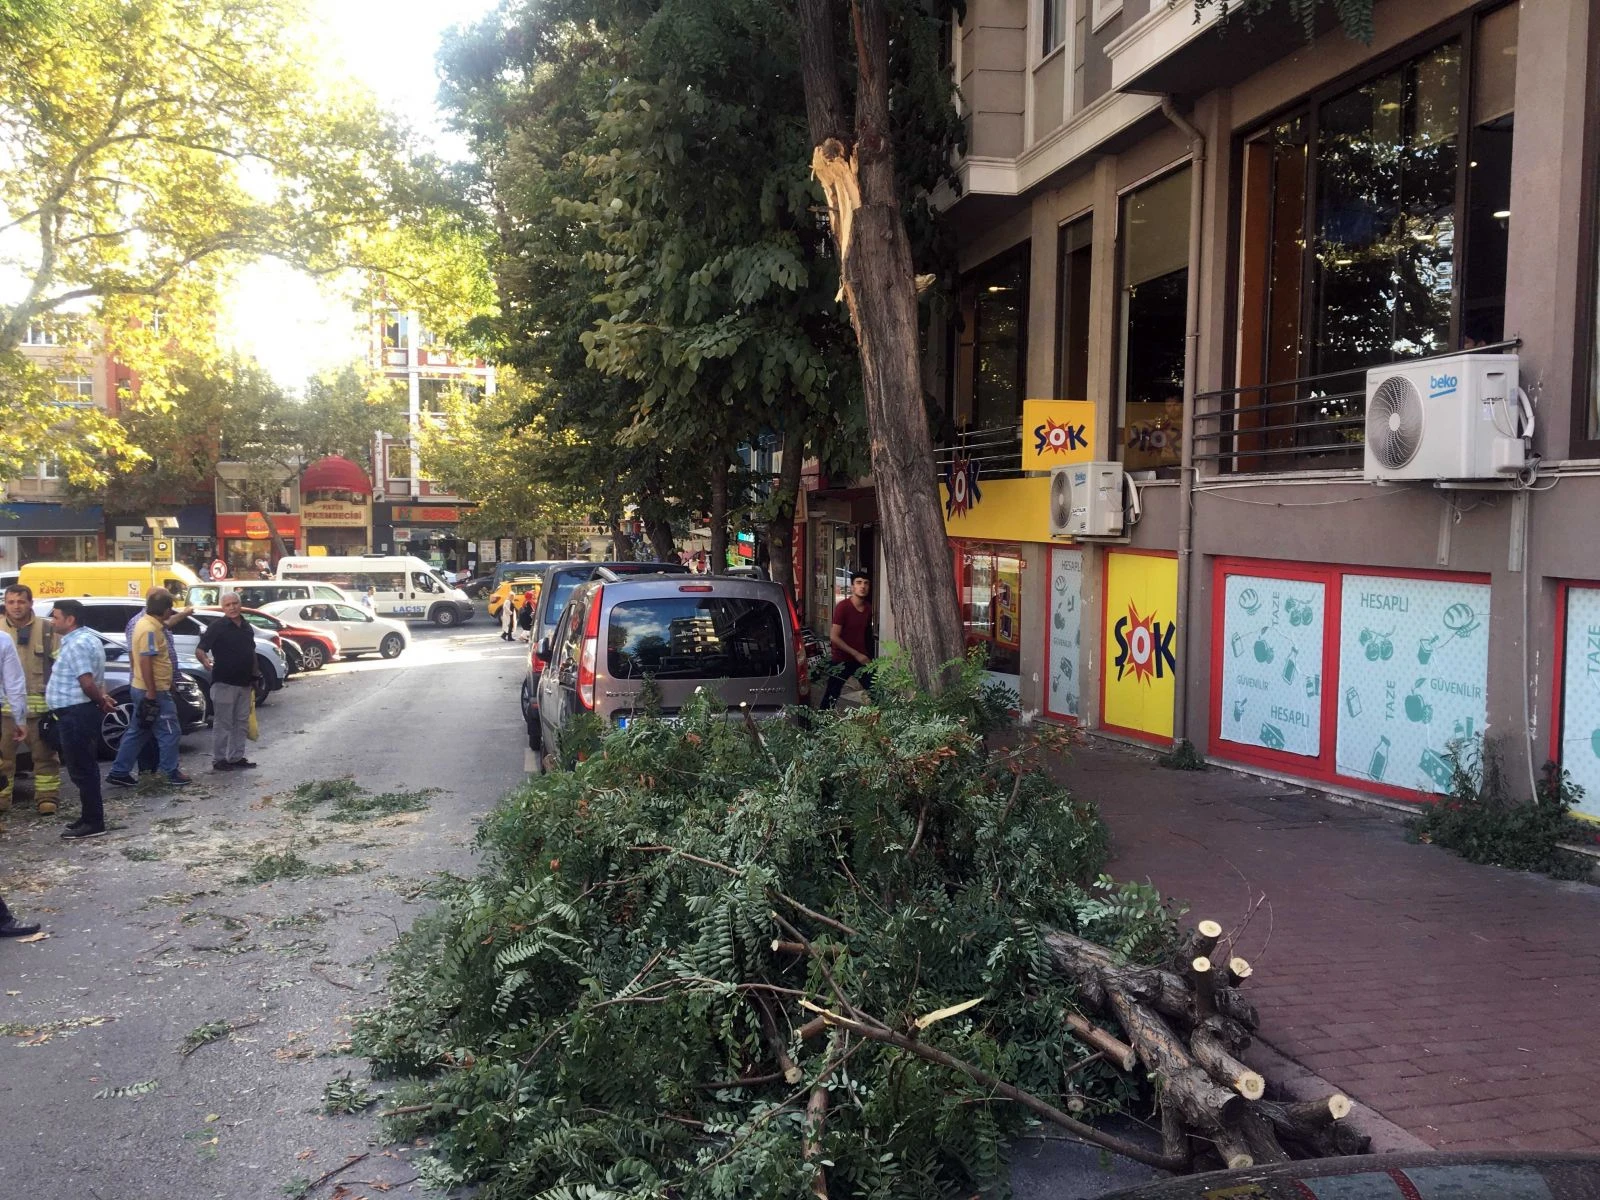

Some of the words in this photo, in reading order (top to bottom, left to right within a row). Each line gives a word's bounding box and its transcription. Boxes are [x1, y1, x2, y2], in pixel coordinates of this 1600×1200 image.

[1430, 374, 1458, 389] beko
[1034, 424, 1088, 456] ŞOK
[1272, 591, 1281, 626] TAZE
[1360, 592, 1409, 613] HESAPLI
[1114, 615, 1176, 682] ŞOK
[1385, 680, 1396, 720] TAZE
[1430, 678, 1481, 699] GÜVENİLİR
[1270, 705, 1311, 728] HESAPLI
